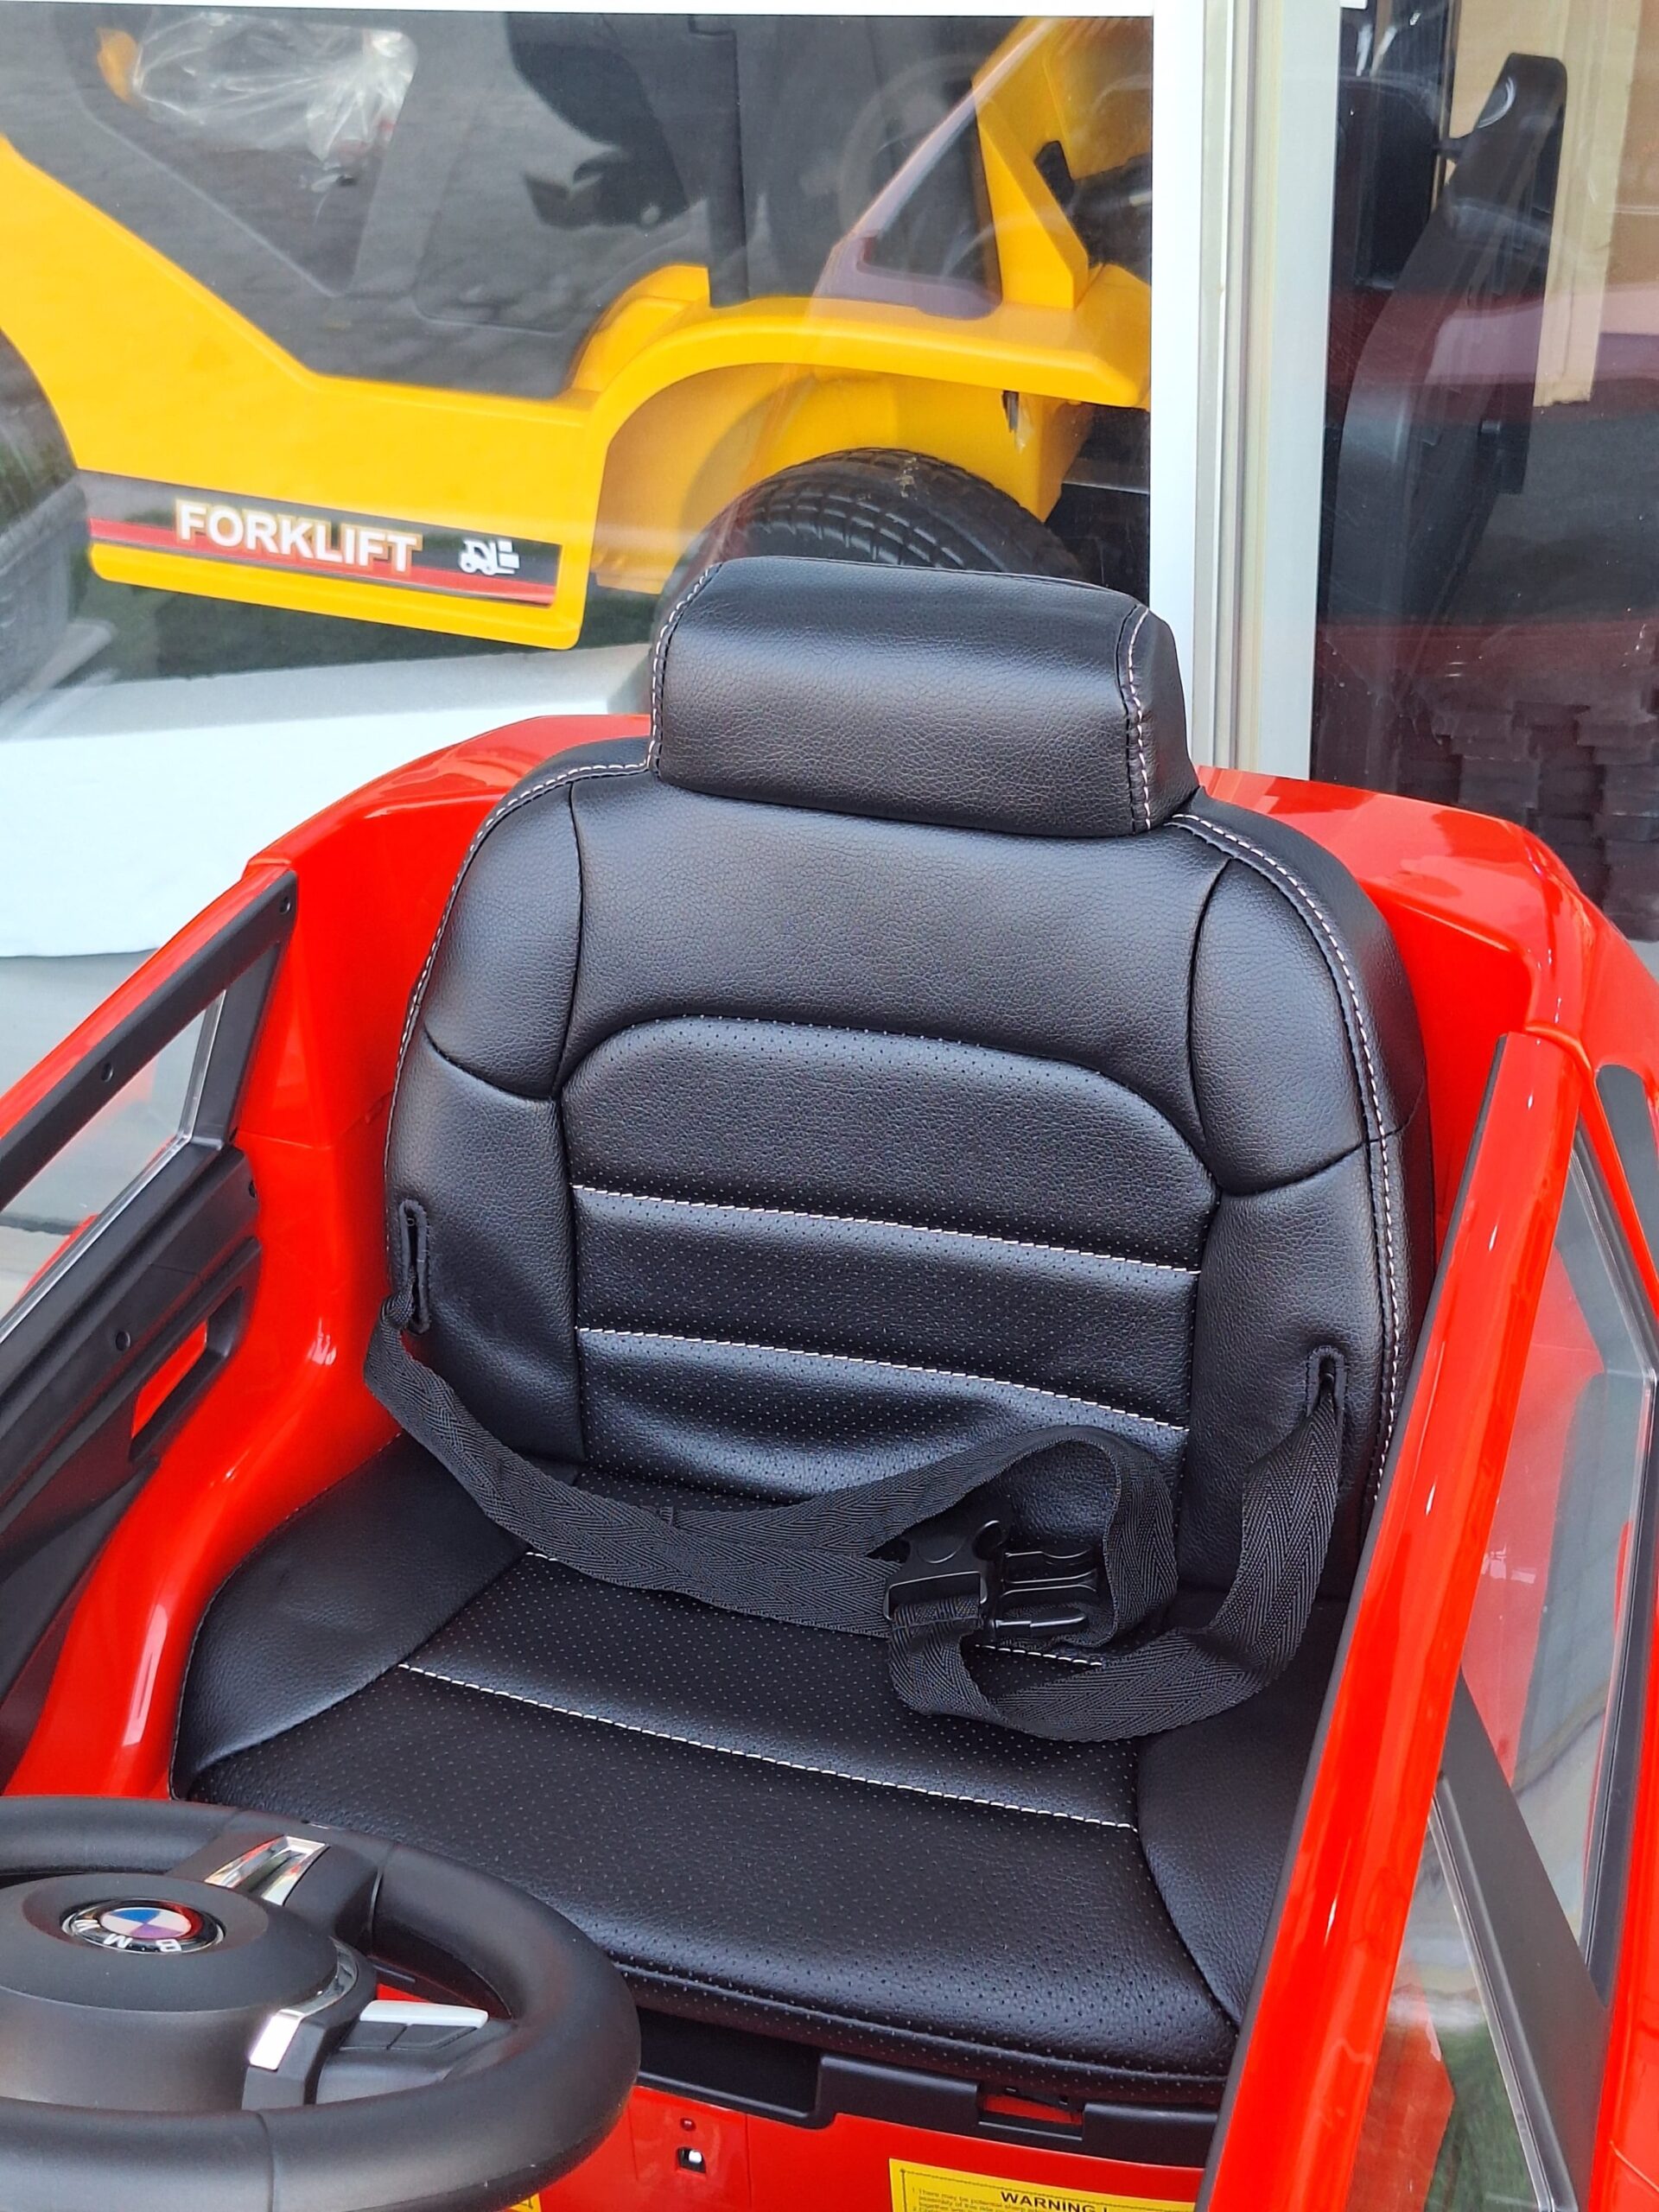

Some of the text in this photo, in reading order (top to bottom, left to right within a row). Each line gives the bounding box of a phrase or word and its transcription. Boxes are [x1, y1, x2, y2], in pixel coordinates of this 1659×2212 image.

[177, 502, 421, 574] FORKLIFT
[71, 1918, 182, 1953] BMW
[1001, 2191, 1096, 2212] WARNING
